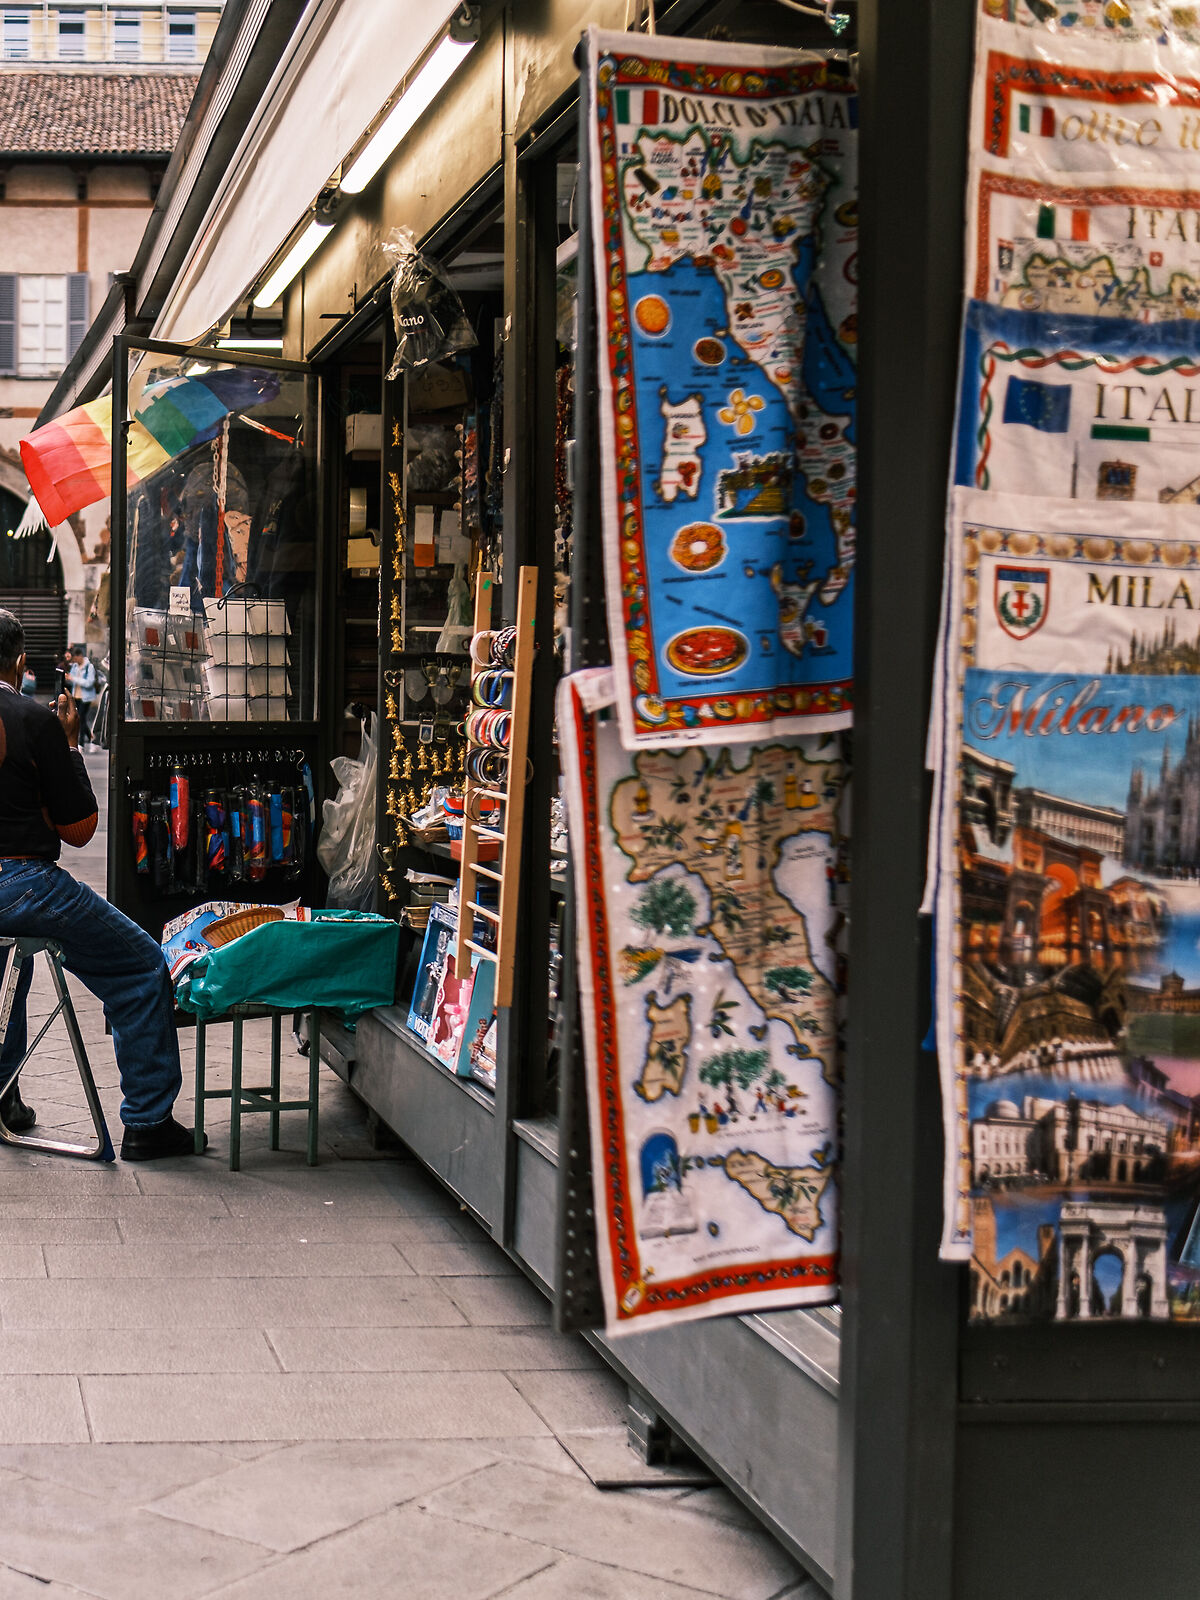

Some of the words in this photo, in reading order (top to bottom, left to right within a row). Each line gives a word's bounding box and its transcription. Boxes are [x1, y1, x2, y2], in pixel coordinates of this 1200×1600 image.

[662, 94, 742, 127] DOLCI
[1085, 572, 1200, 610] MILA
[967, 679, 1186, 740] Milano
